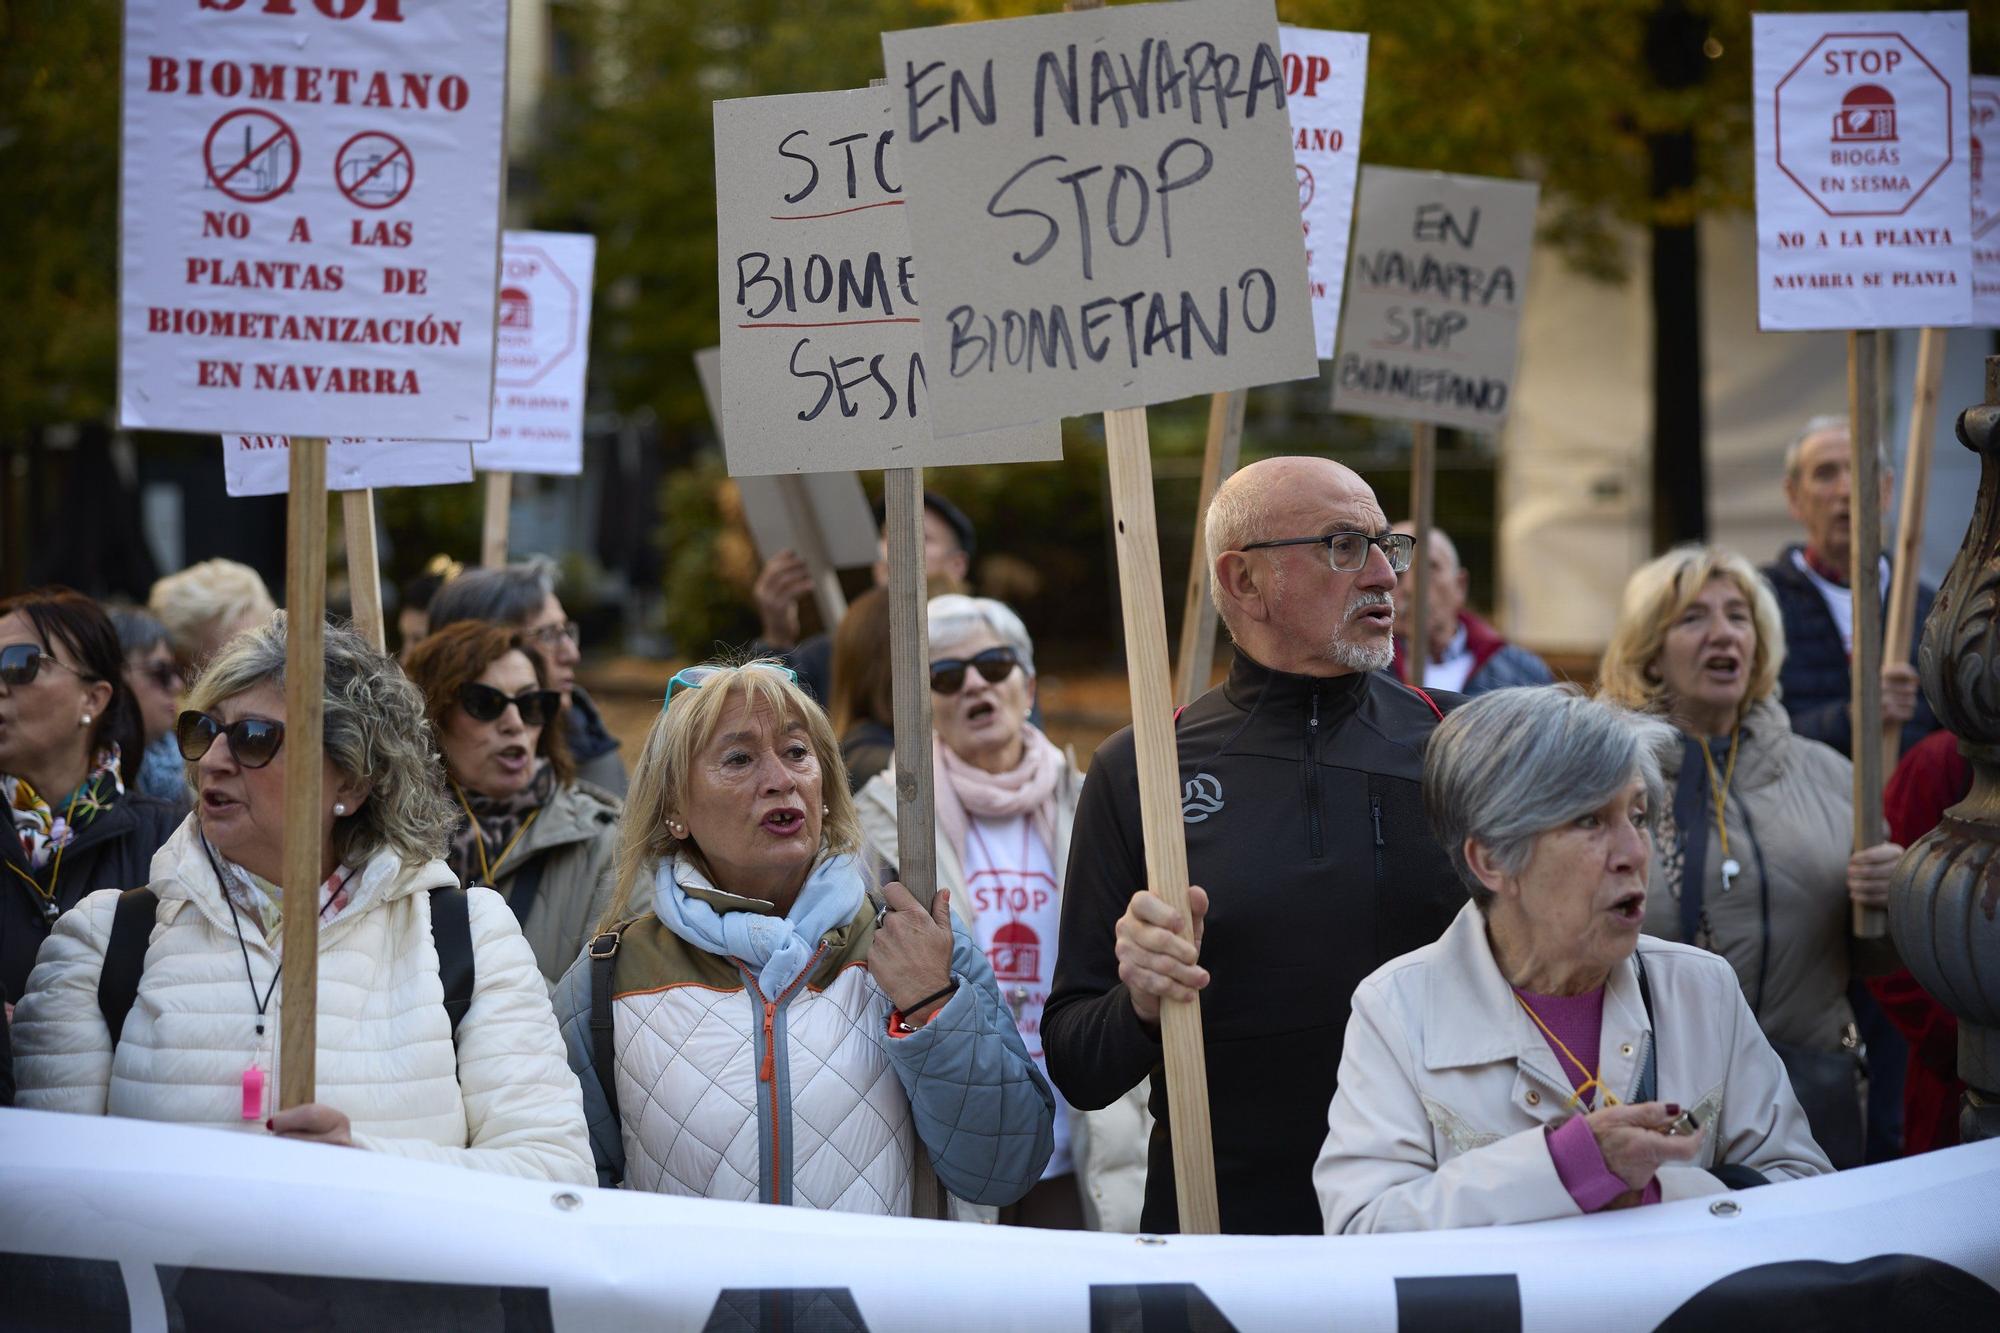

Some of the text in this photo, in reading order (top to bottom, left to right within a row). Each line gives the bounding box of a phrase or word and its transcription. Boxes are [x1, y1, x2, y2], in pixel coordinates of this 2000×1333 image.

[1282, 52, 1331, 97] OP
[1824, 50, 1902, 75] STOP
[148, 56, 470, 111] BIOMETANO
[906, 37, 1285, 142] EN NAVARRA
[778, 130, 902, 203] STO
[1830, 143, 1901, 166] BIOGÁS
[1820, 176, 1911, 192] EN SESMA
[987, 138, 1213, 279] STOP
[1414, 203, 1480, 249] EN
[202, 211, 413, 247] NO A LAS
[1777, 228, 1953, 248] NO A LA PLANTA
[185, 258, 427, 295] PLANTAS DE
[737, 251, 919, 318] BIOME
[1773, 271, 1957, 288] NAVARRA SE PLANTA
[148, 307, 461, 346] BIOMETANIZACIÓN
[946, 268, 1277, 378] BIOMETANO
[1384, 306, 1468, 350] STOP
[197, 360, 421, 395] EN NAVARRA
[975, 888, 1049, 912] STOP
